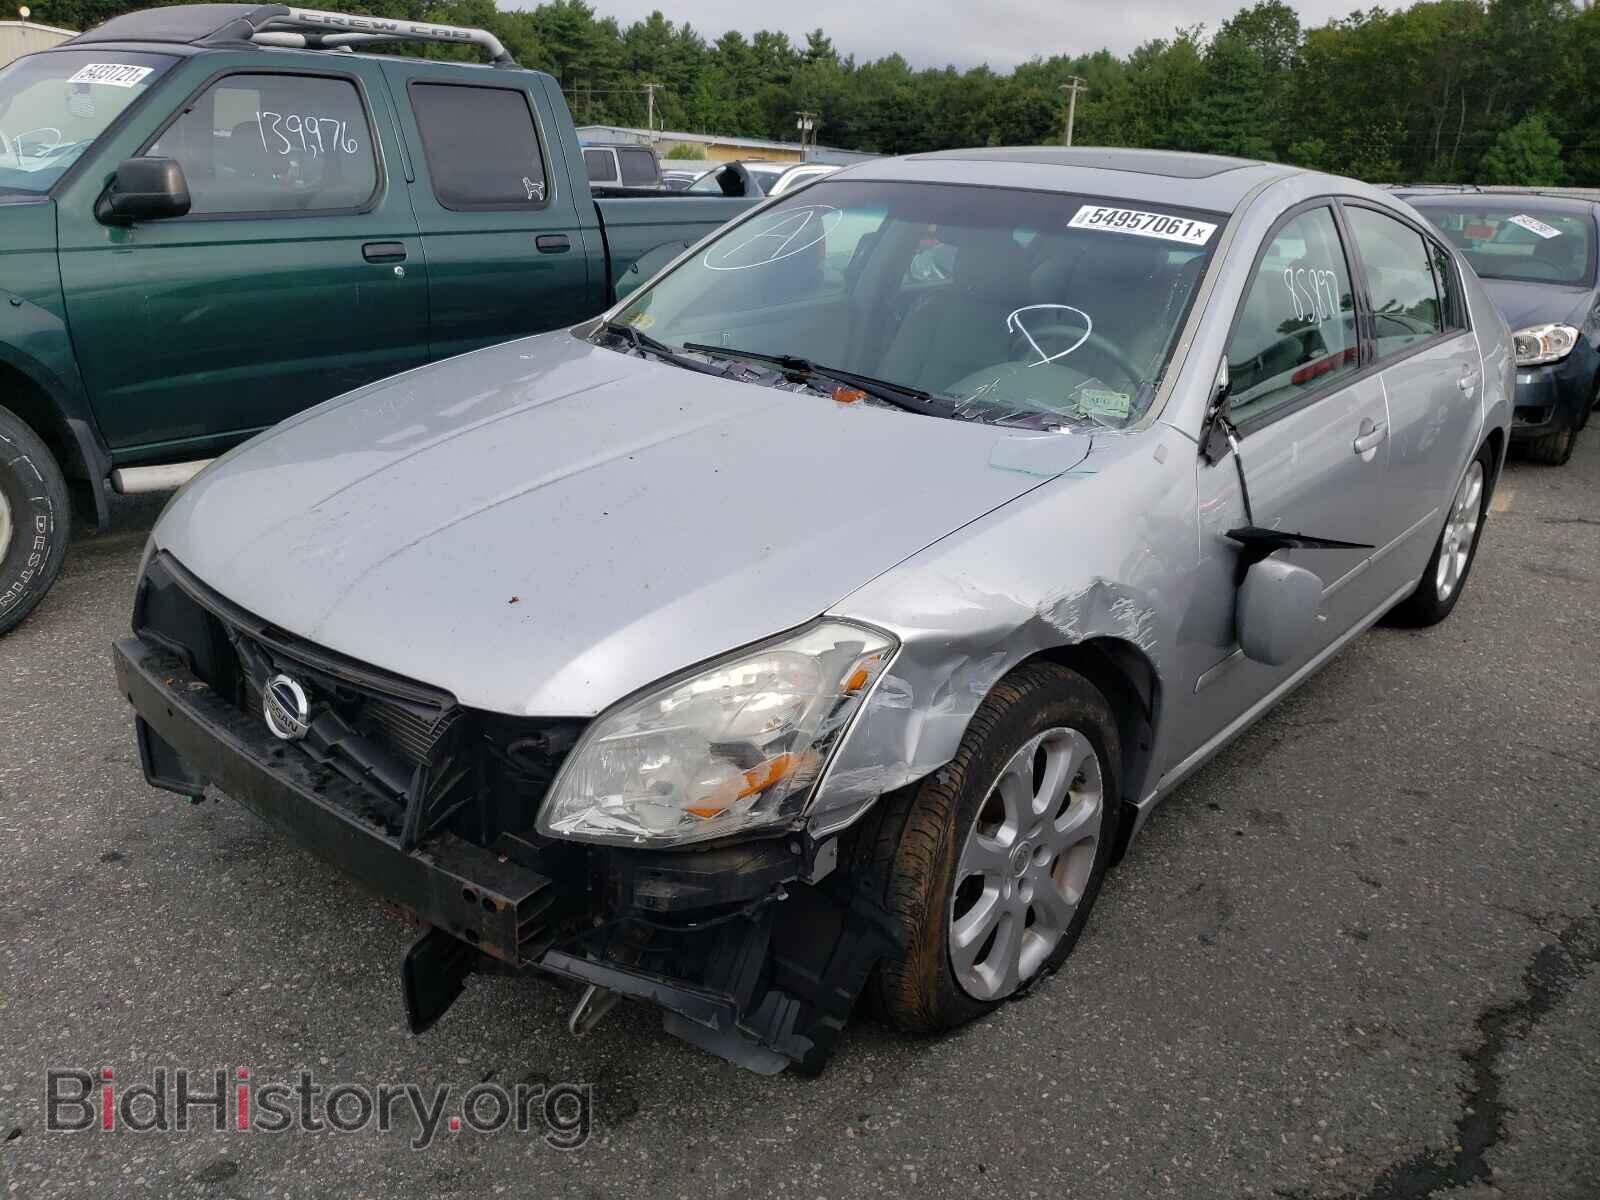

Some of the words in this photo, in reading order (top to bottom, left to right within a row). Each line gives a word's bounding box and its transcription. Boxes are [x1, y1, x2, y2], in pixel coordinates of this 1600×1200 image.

[298, 13, 399, 32] CREW
[409, 24, 473, 40] CAB
[255, 111, 359, 160] 139,976
[1088, 207, 1196, 238] 54957061
